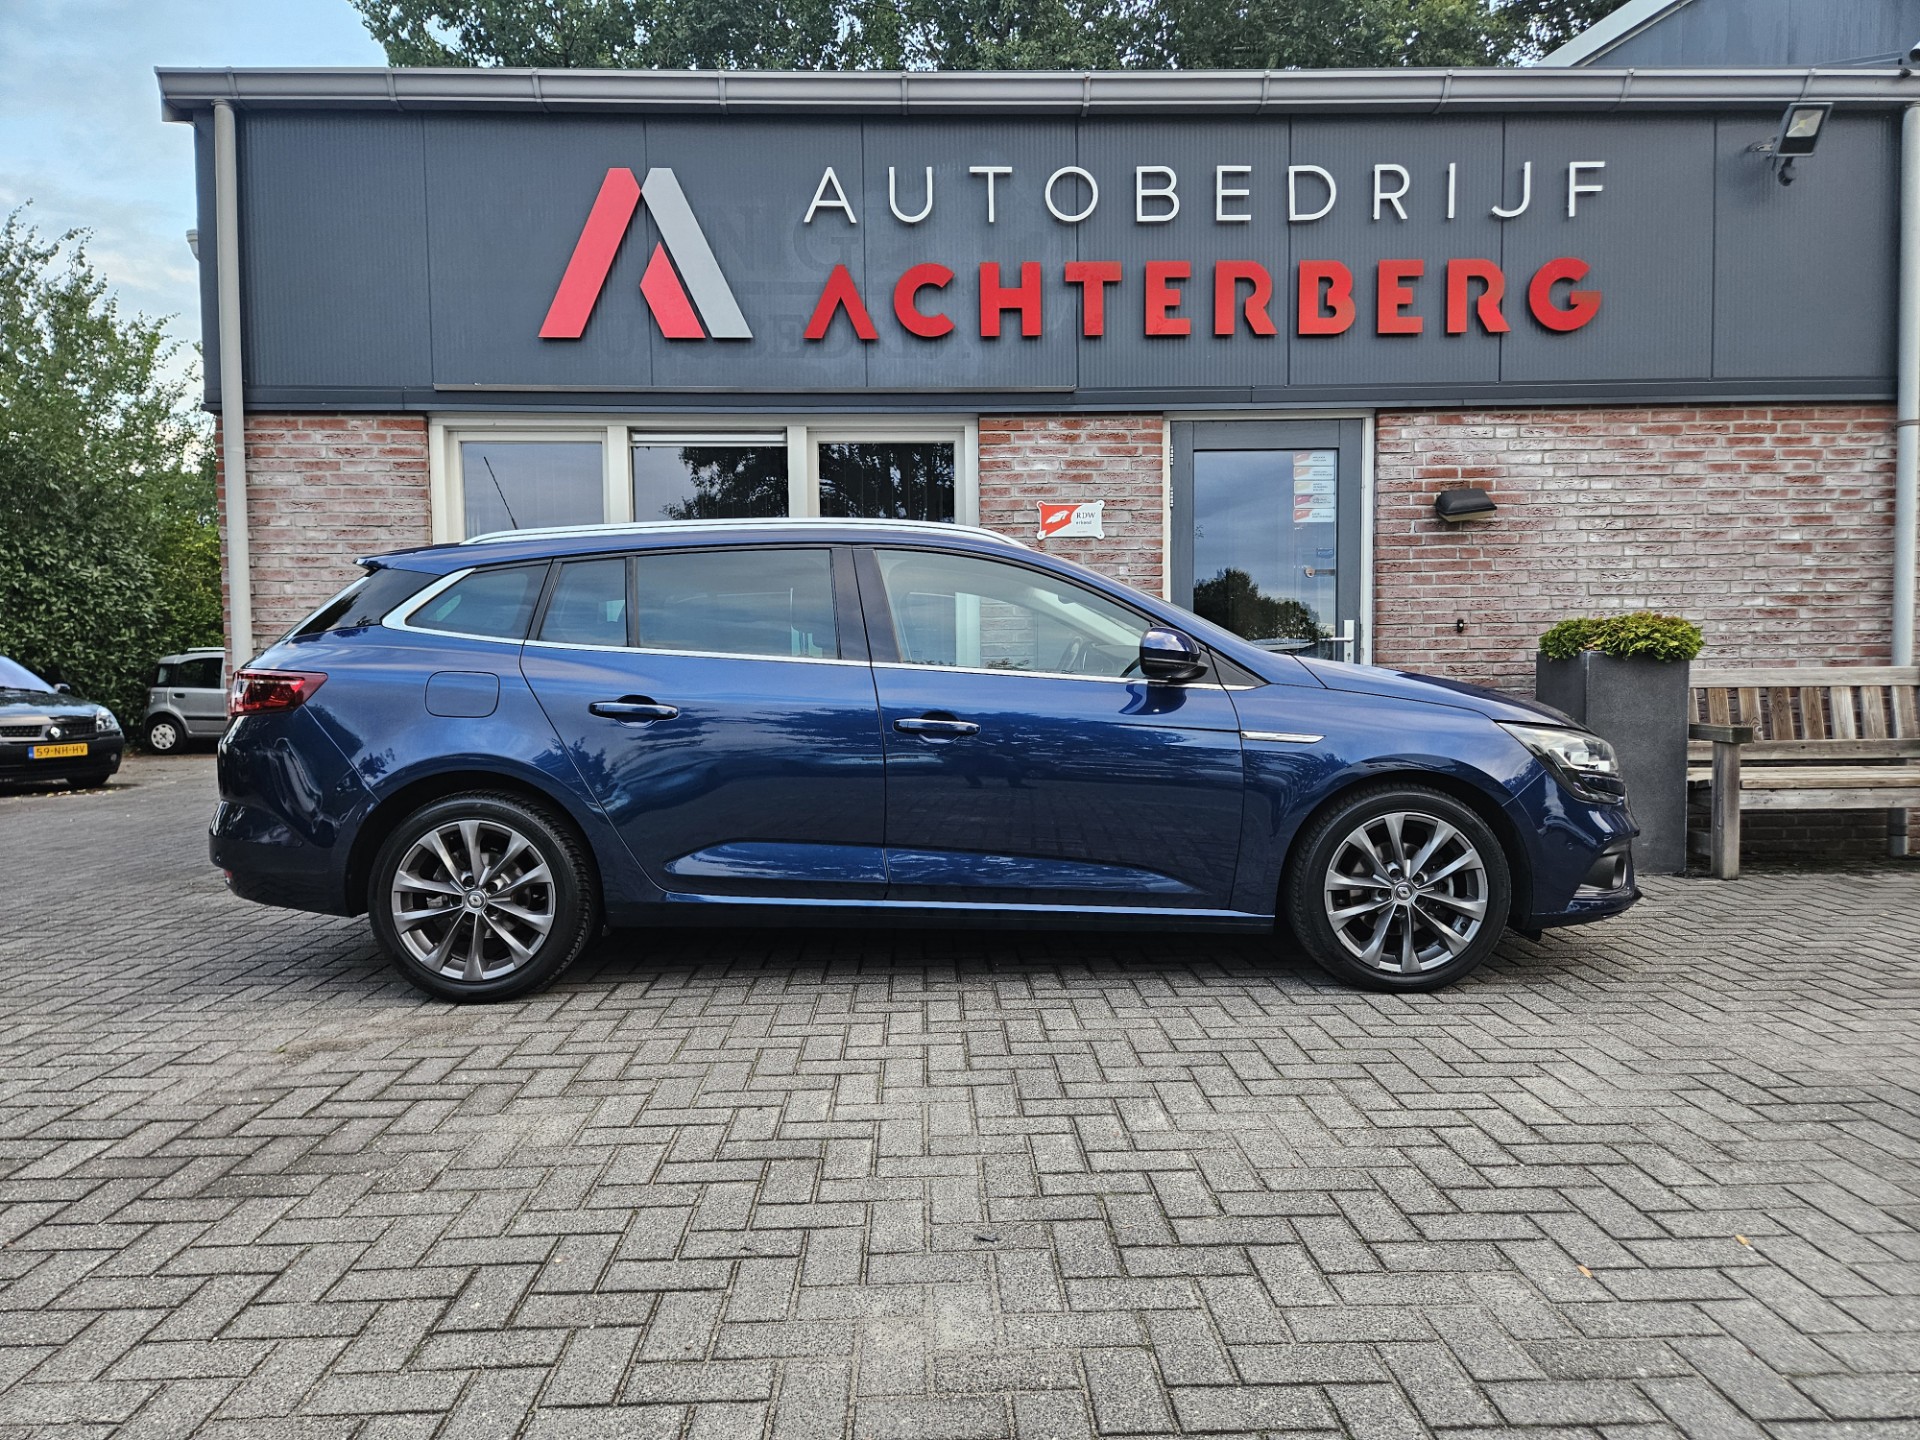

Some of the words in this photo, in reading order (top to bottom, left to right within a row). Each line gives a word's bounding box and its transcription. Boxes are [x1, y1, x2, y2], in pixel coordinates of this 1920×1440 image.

[803, 160, 1606, 224] AUTOBEDRIJF
[803, 257, 1602, 340] ACHTERBERG
[36, 745, 85, 757] 59-NH-HV
